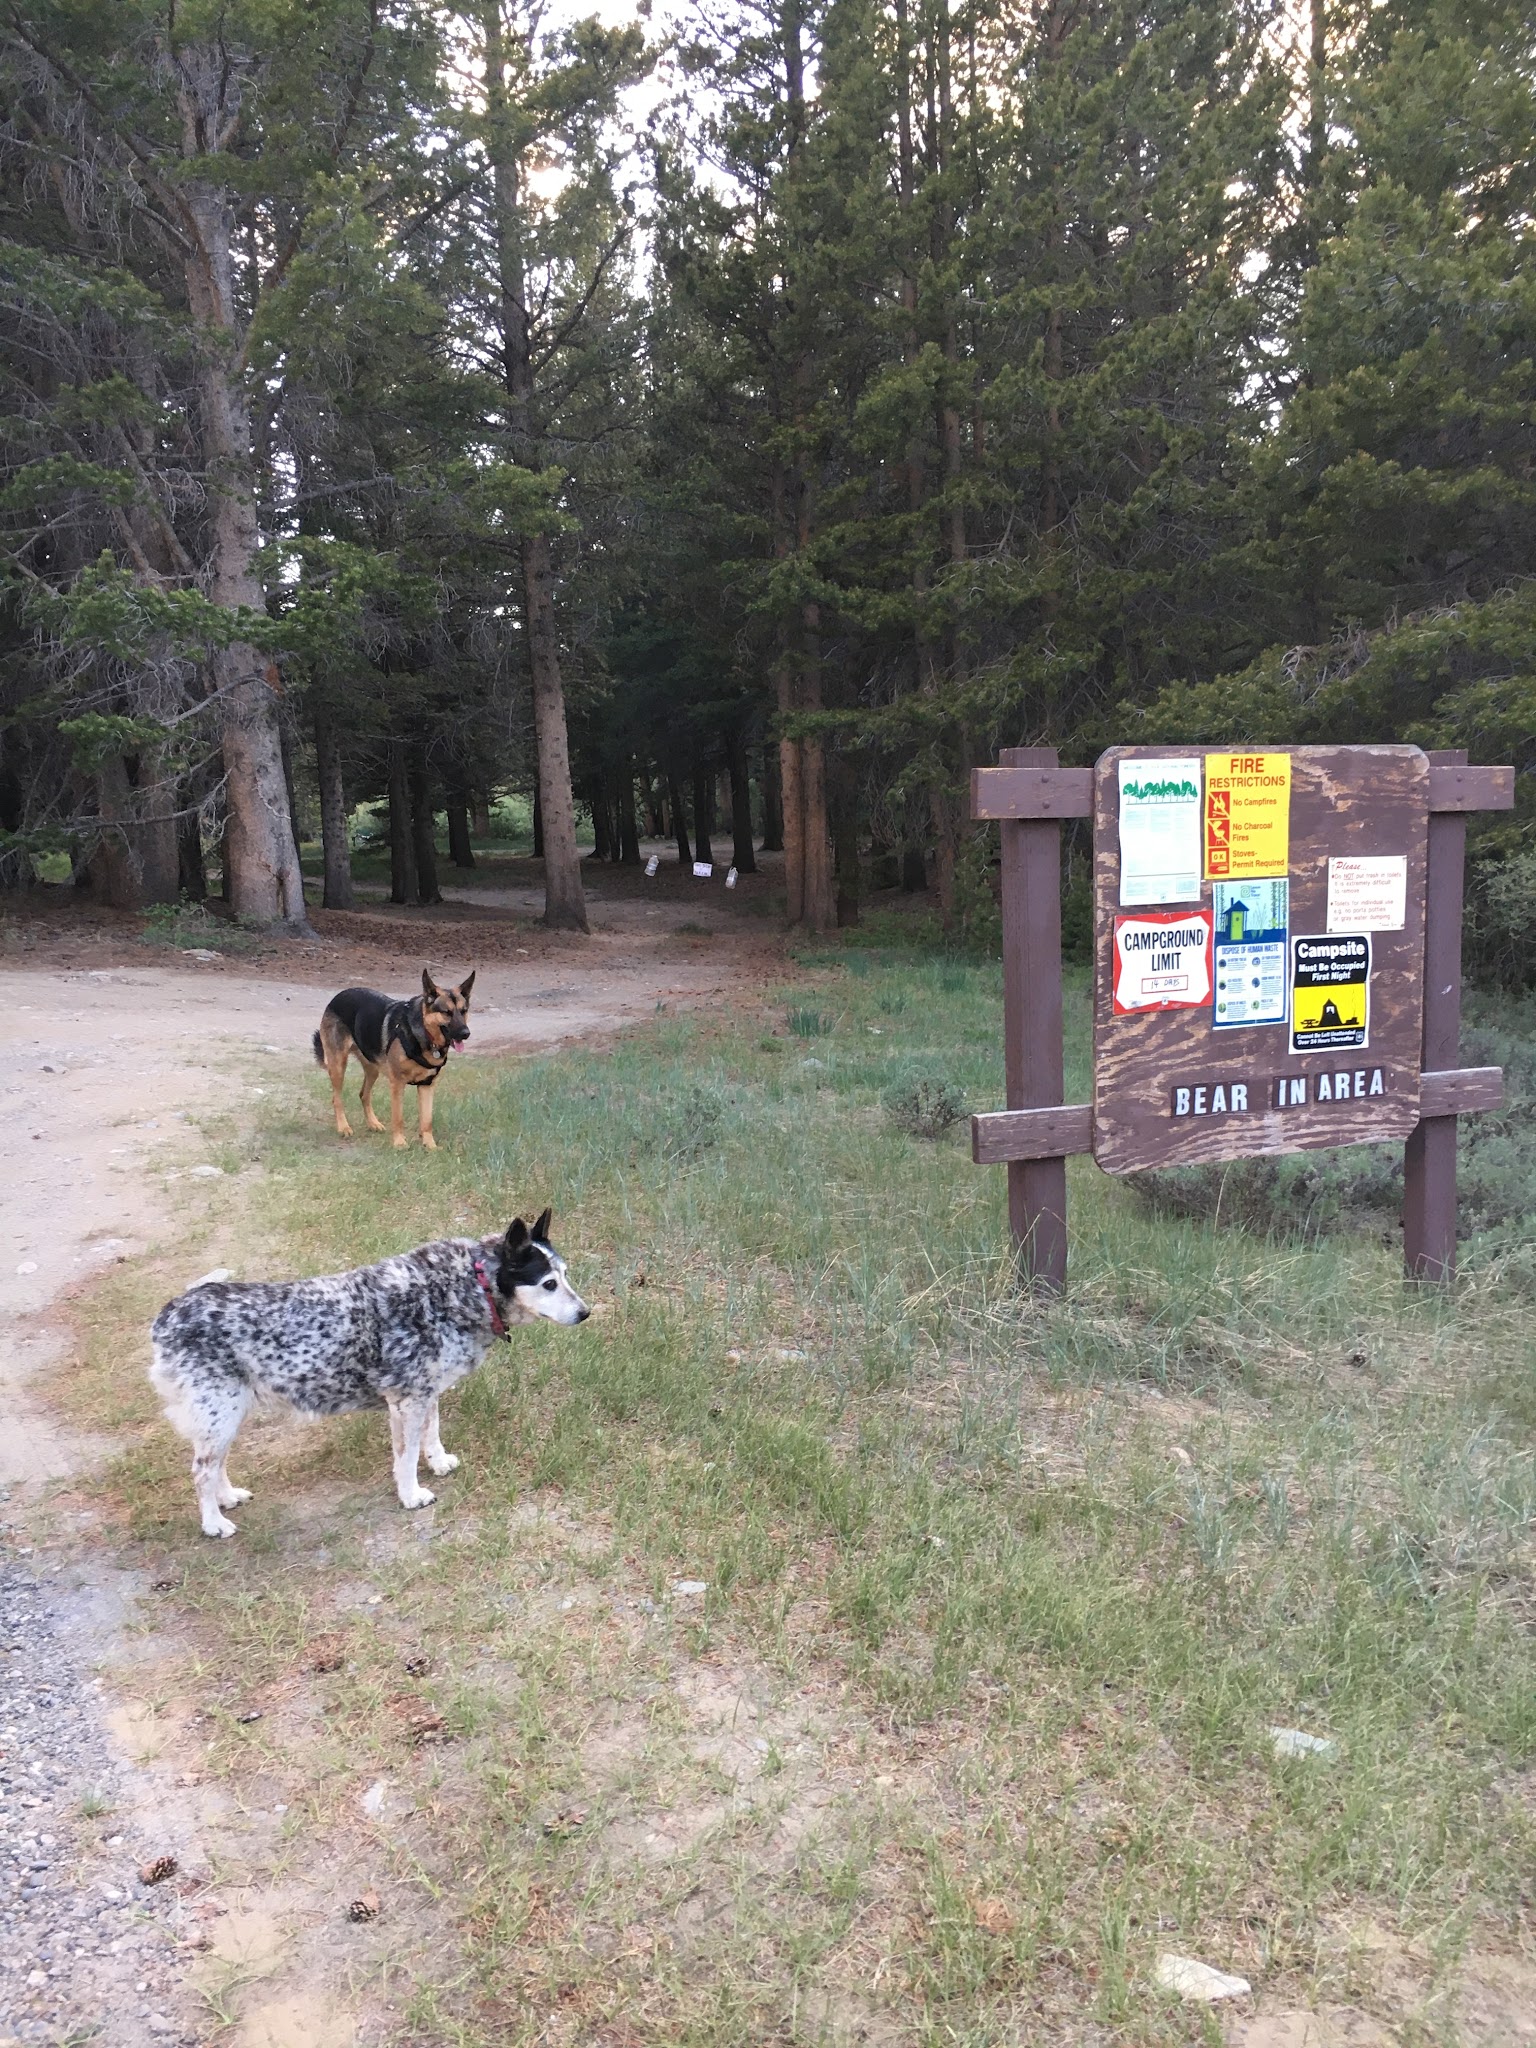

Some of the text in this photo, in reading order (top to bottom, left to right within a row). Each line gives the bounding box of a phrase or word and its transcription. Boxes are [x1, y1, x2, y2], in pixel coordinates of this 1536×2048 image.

[1231, 758, 1264, 773] FIRE
[1210, 776, 1285, 788] RESTRICTIONS
[1244, 798, 1277, 807] Campfires
[1244, 822, 1273, 830] Charcoal
[1233, 859, 1285, 868] Permit Required
[1124, 929, 1203, 952] CAMPGROUND
[1222, 946, 1240, 955] DISPOSE
[1248, 945, 1263, 953] HUMAN
[1298, 941, 1365, 959] Campsite
[1152, 952, 1181, 971] LIMIT
[1298, 961, 1365, 972] Must Be Occupied
[1312, 972, 1351, 981] First Night
[1151, 979, 1159, 990] 14
[1176, 1069, 1384, 1116] BEAR IN AREA
